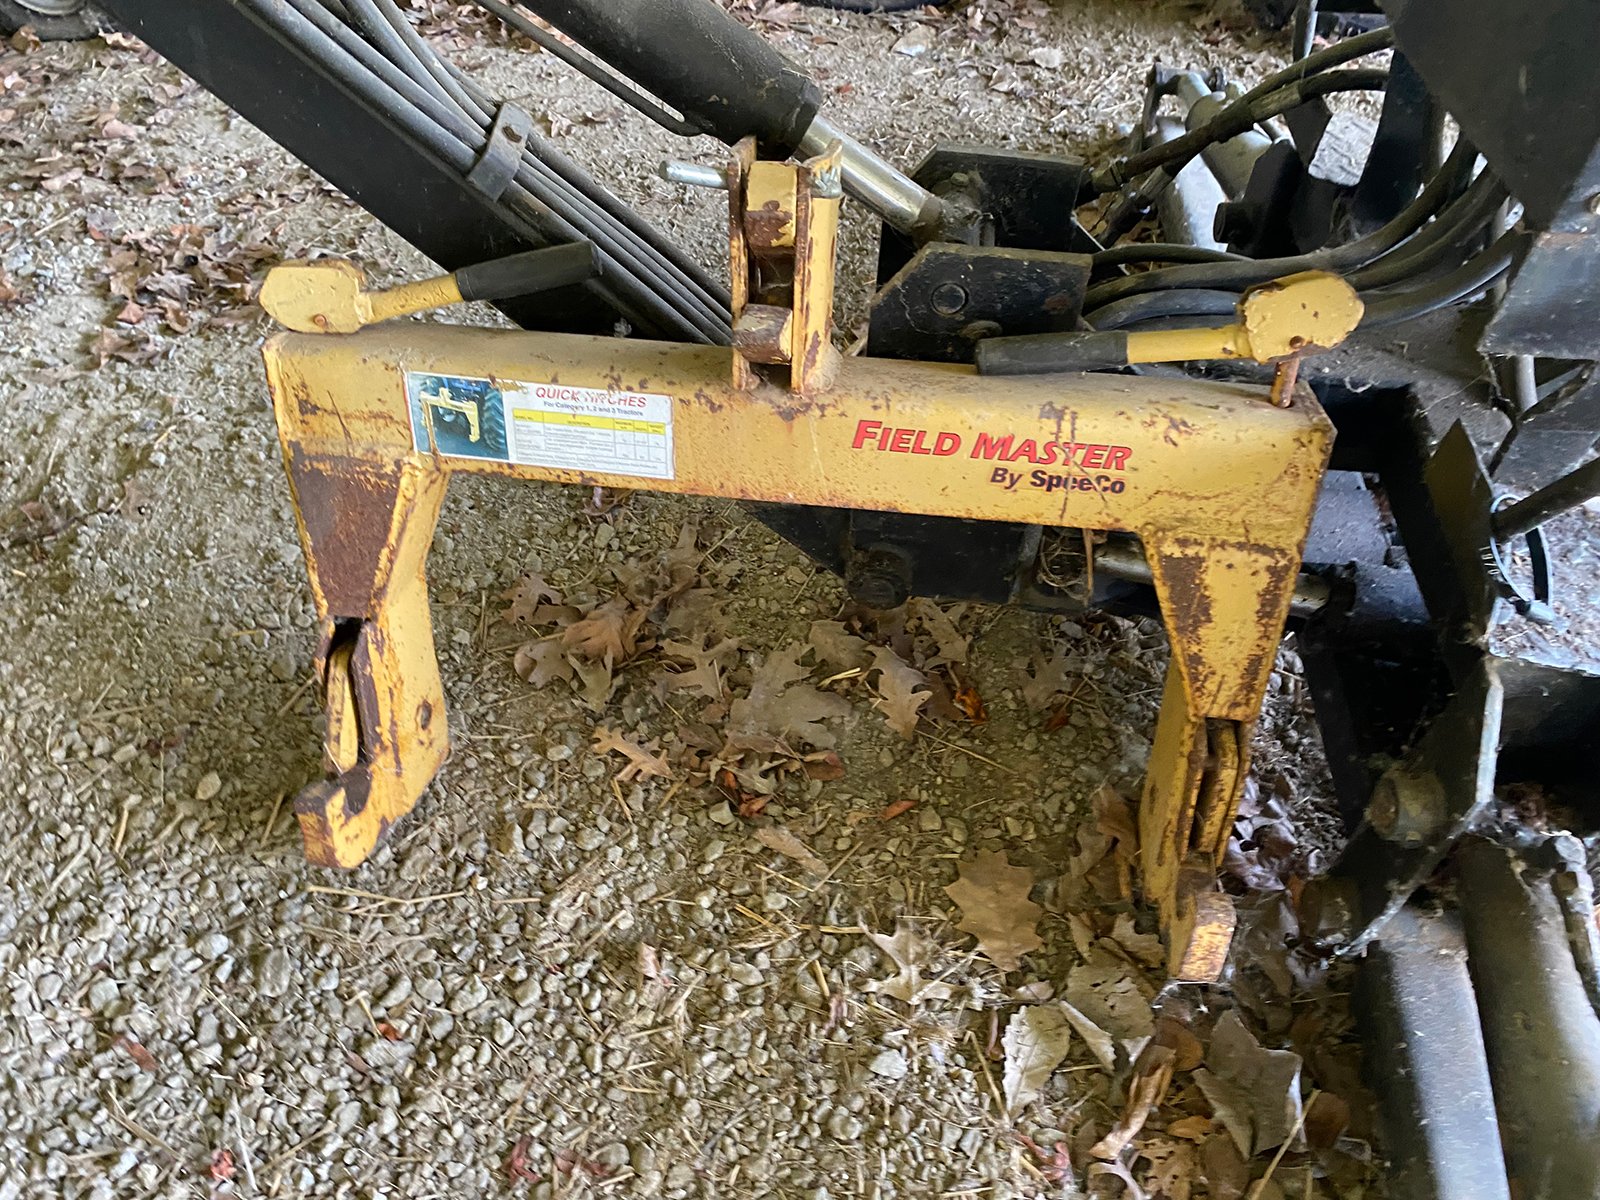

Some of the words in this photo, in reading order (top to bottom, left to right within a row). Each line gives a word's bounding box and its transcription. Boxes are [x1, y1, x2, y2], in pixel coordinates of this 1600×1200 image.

[535, 387, 580, 402] QUICK
[852, 420, 961, 457] FIELD
[970, 432, 1133, 471] MASTER
[991, 467, 1023, 490] By
[1030, 470, 1126, 494] SpeeCo
